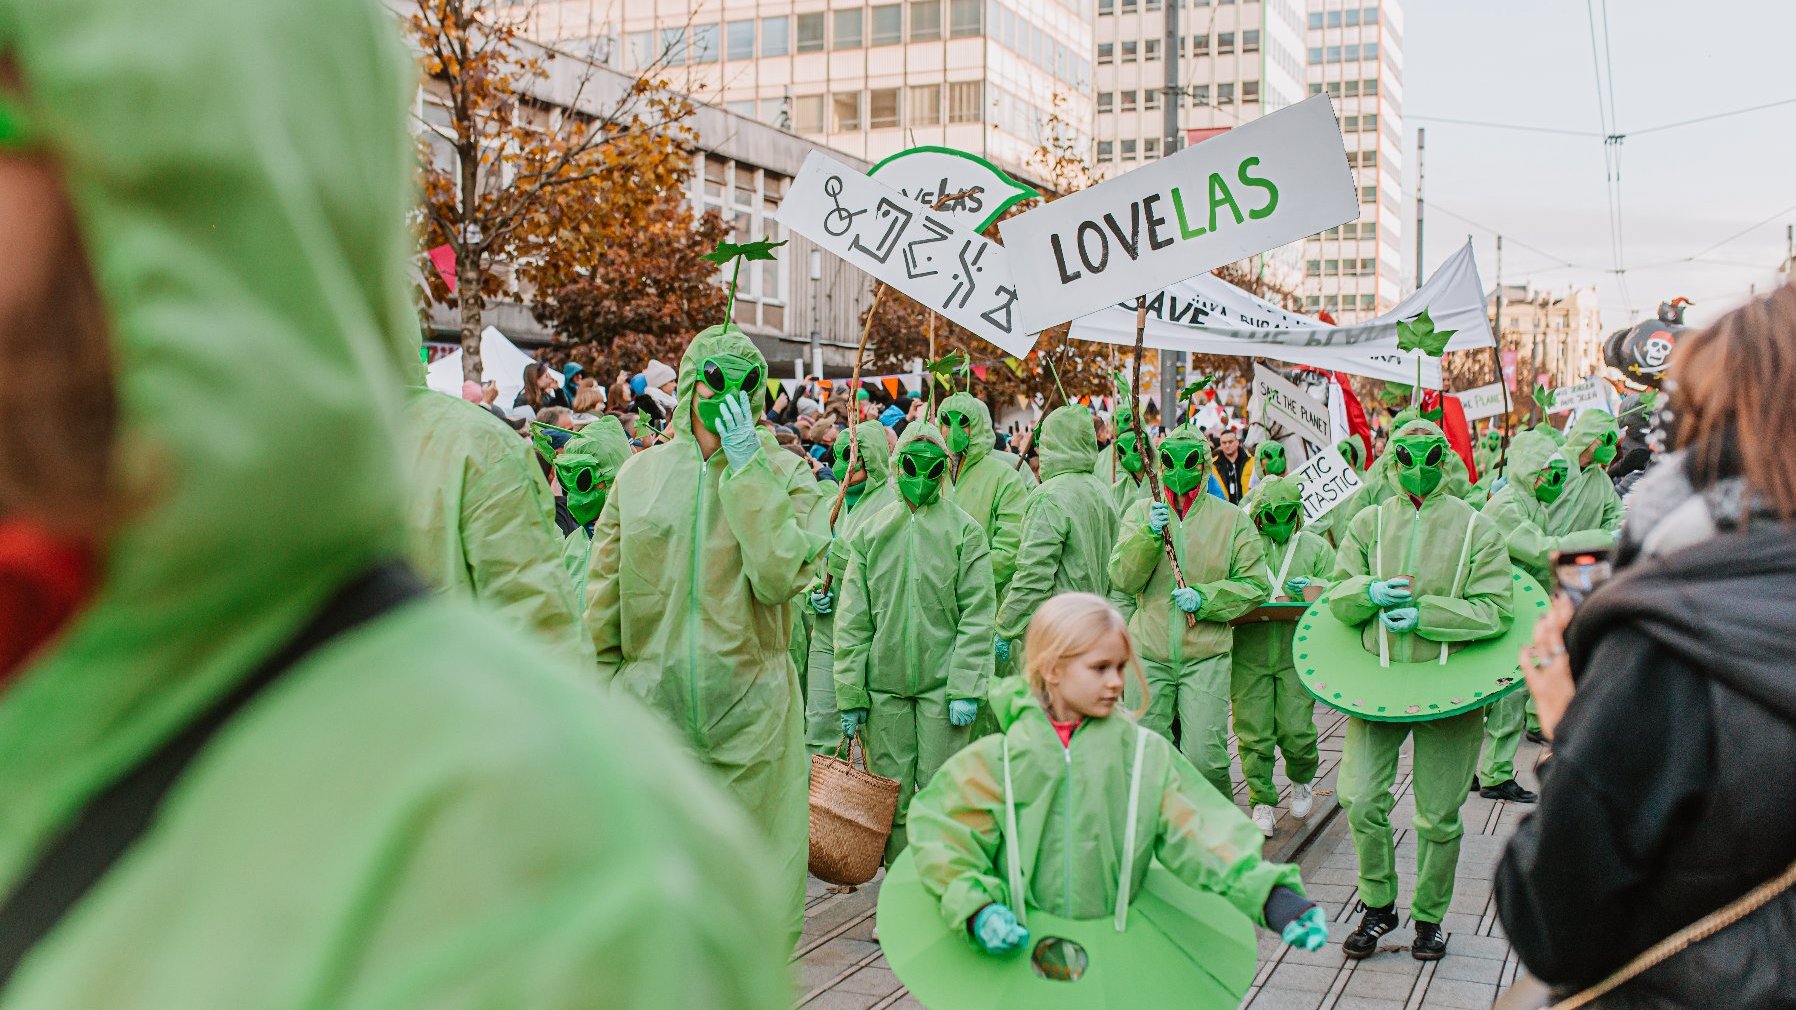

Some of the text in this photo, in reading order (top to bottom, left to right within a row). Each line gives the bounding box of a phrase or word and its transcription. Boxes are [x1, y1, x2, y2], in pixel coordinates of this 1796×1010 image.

[901, 177, 985, 213] VELAS
[1051, 157, 1279, 284] LOVELAS
[1282, 394, 1297, 415] THE
[1300, 405, 1327, 436] PLANET
[1300, 456, 1332, 484] TIC
